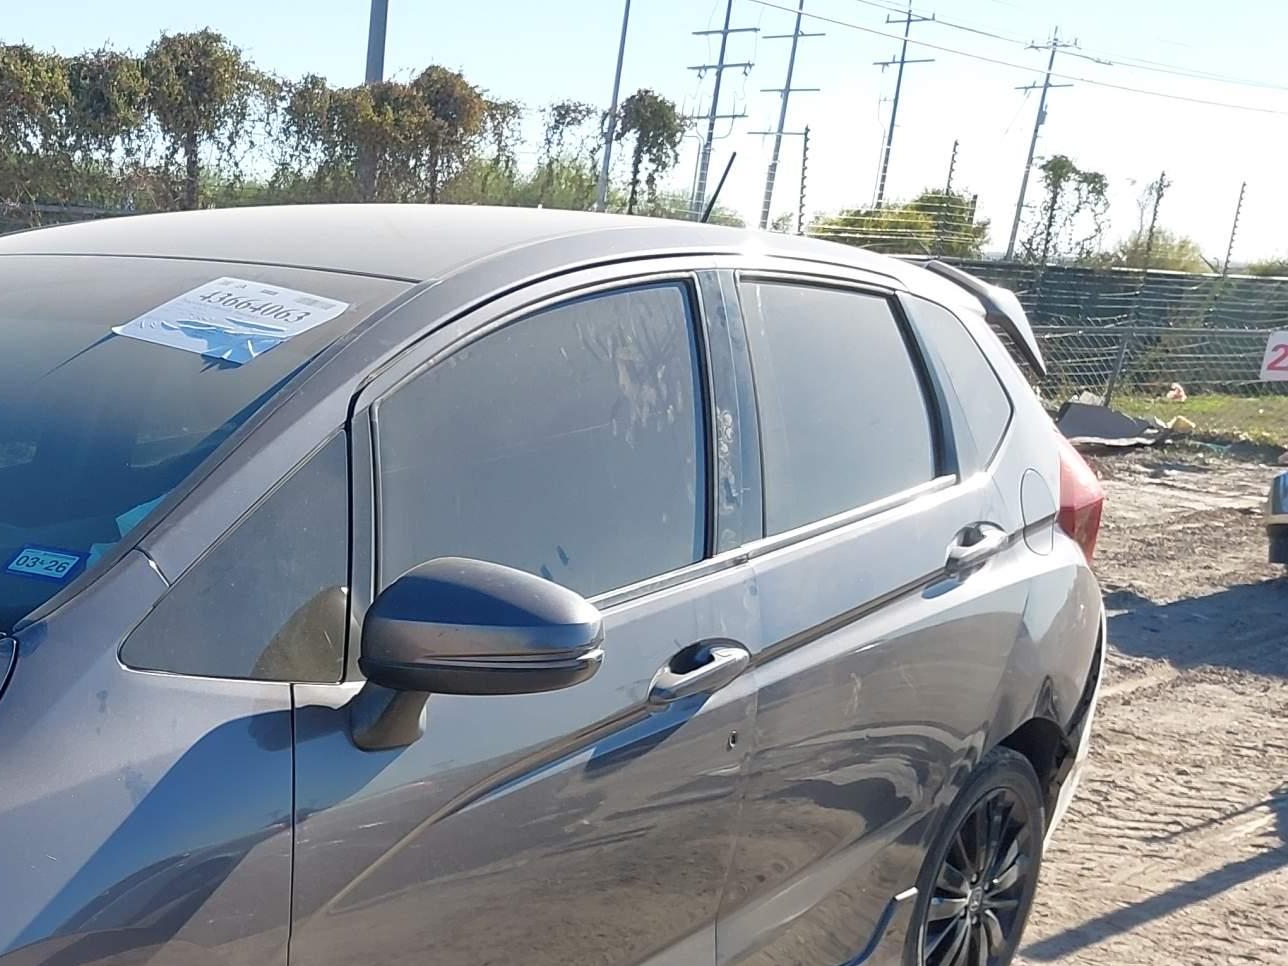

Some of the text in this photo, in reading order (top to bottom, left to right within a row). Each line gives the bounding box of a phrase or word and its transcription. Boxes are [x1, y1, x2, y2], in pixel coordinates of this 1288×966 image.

[199, 289, 312, 324] 43664063
[15, 555, 70, 573] 03 26
